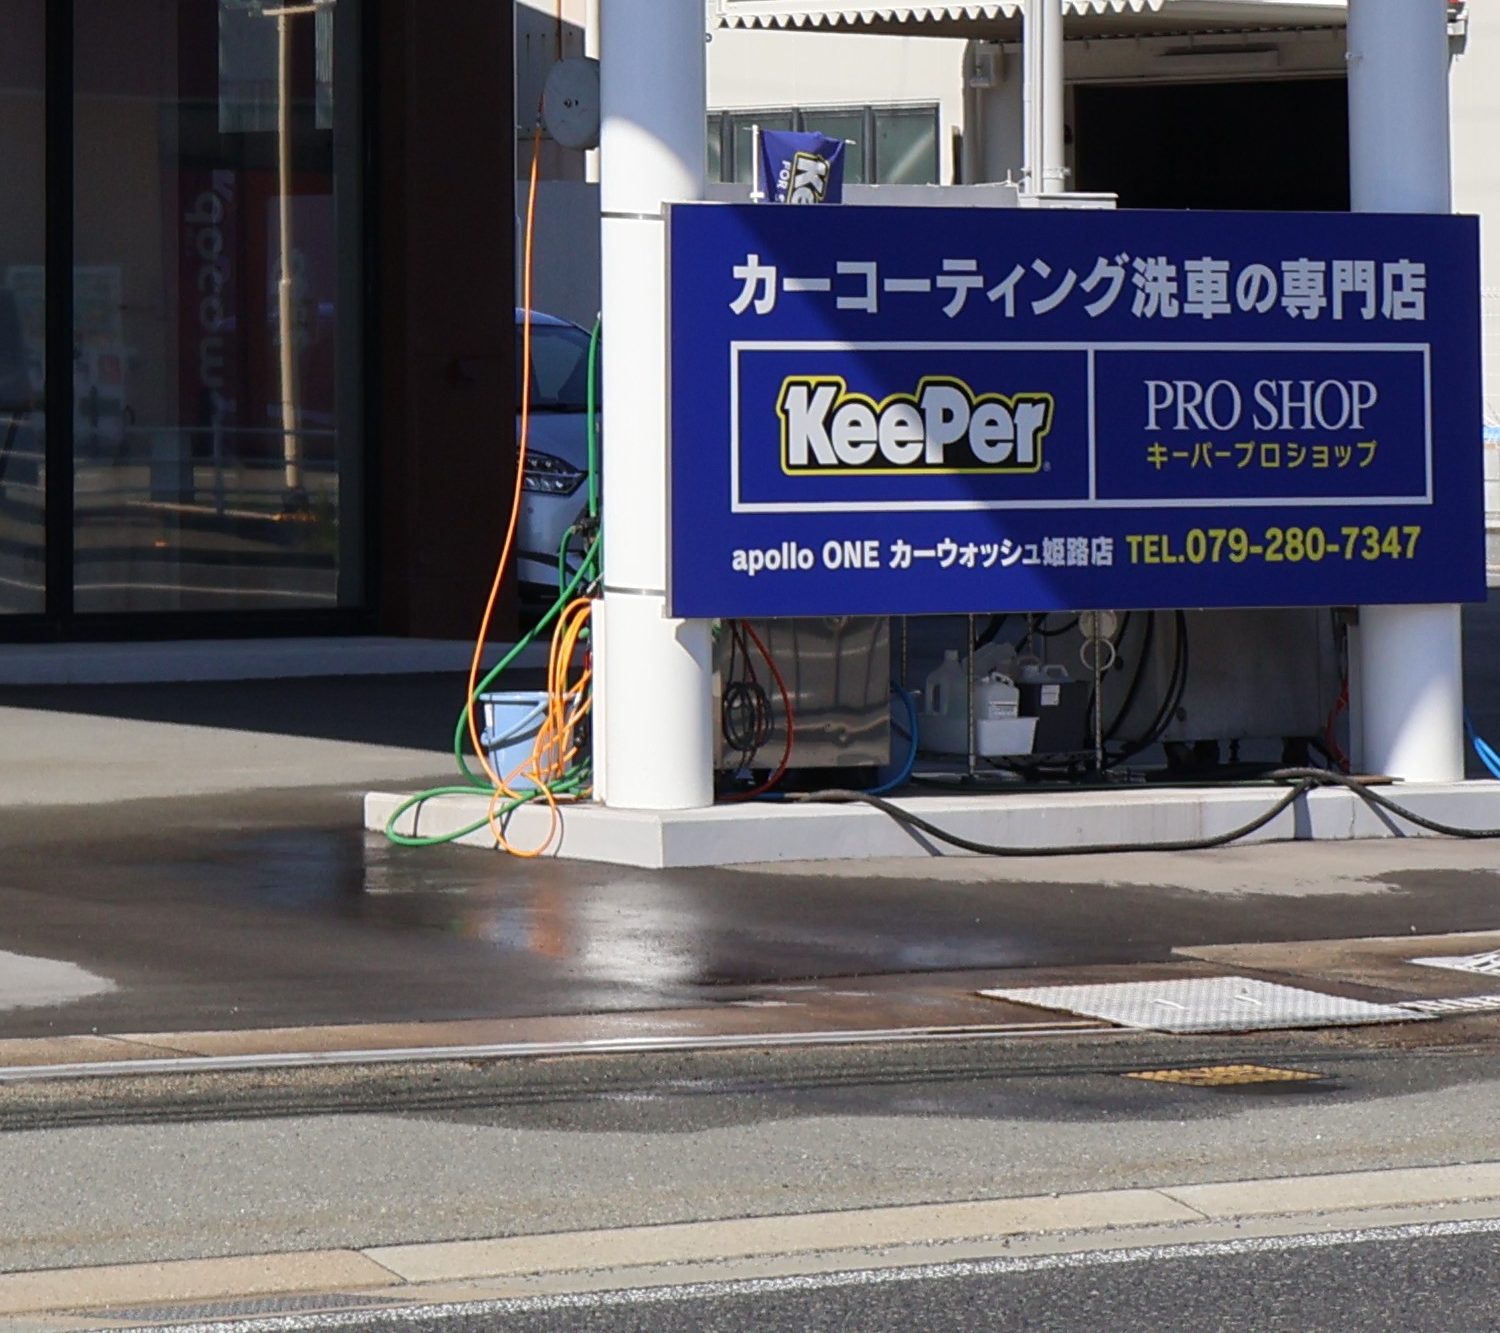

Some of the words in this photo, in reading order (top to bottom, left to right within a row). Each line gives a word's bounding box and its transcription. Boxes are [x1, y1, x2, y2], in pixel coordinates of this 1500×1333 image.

[729, 252, 1427, 320] カーコーティング洗車の専門店
[783, 381, 1046, 466] KeePer
[1145, 379, 1241, 431] PRO
[1252, 379, 1378, 431] SHOP
[1147, 441, 1377, 469] キーパープロショップ
[732, 541, 814, 576] apollo
[822, 539, 881, 569] ONE
[889, 536, 1114, 569] カーウォッシュ姫路店
[1127, 526, 1422, 565] TEL.079-280-7347
